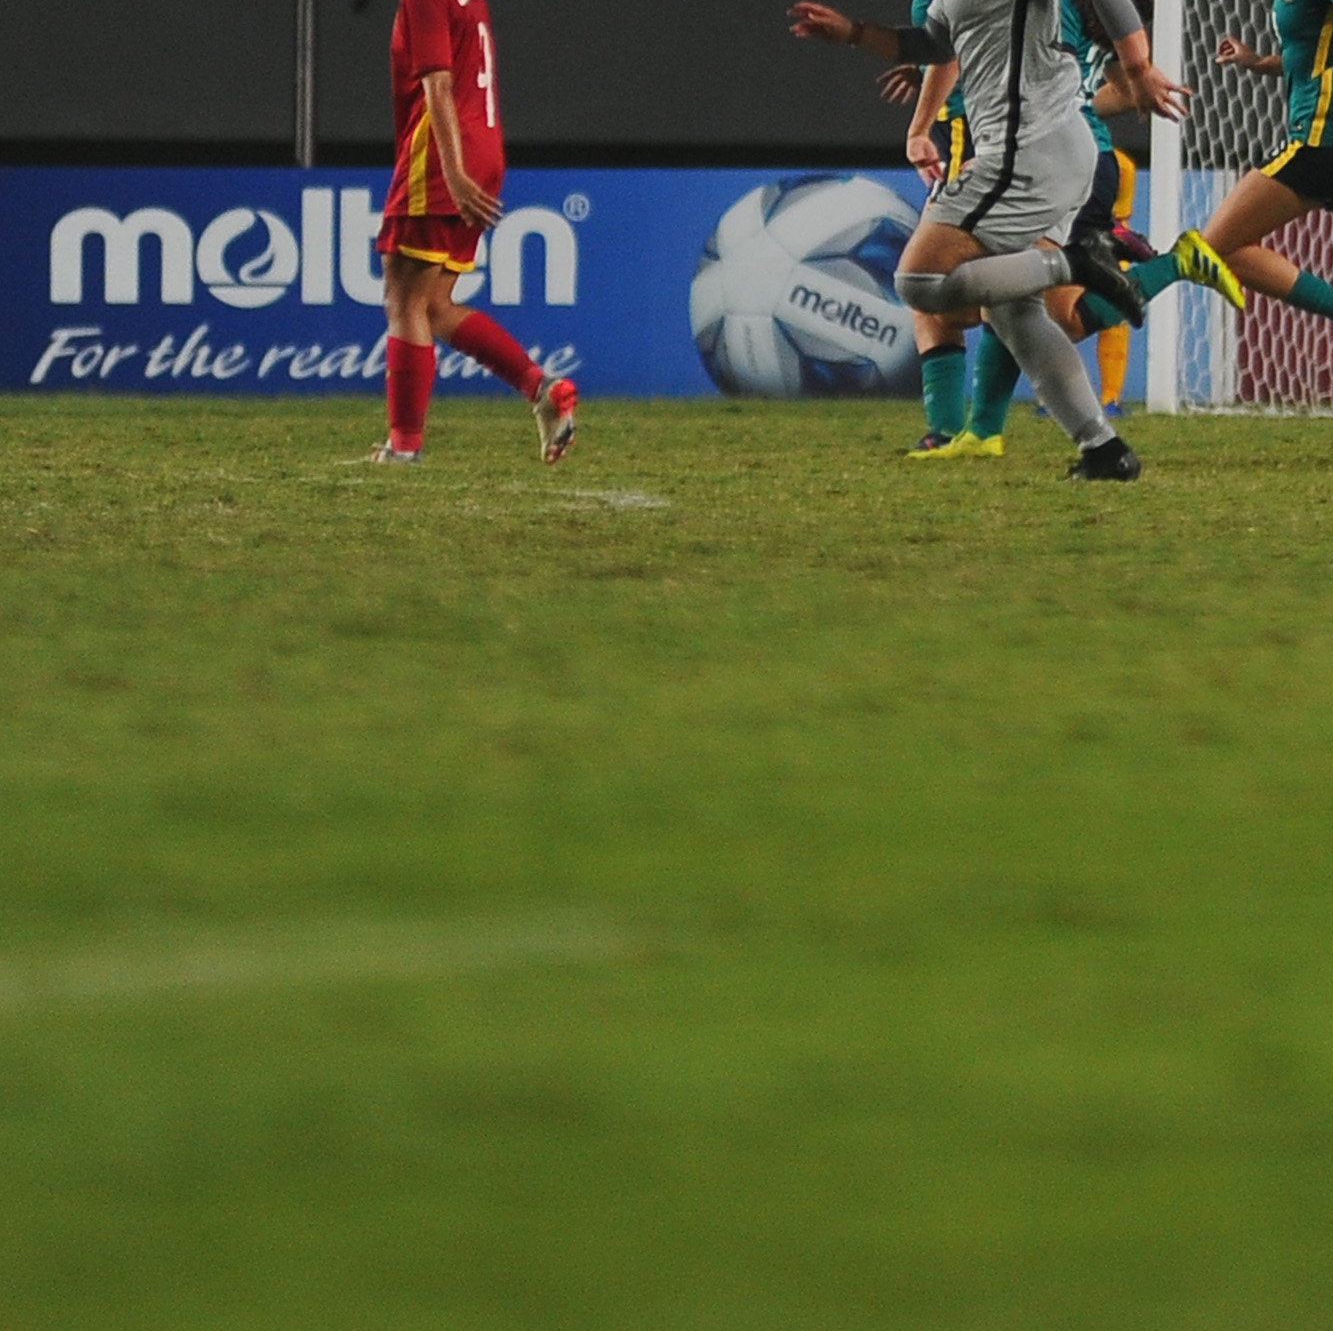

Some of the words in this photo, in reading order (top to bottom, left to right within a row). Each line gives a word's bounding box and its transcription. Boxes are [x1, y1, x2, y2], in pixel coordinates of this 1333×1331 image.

[49, 187, 579, 309] moltn
[788, 284, 898, 348] molten
[29, 326, 137, 384] For
[147, 324, 252, 379] the
